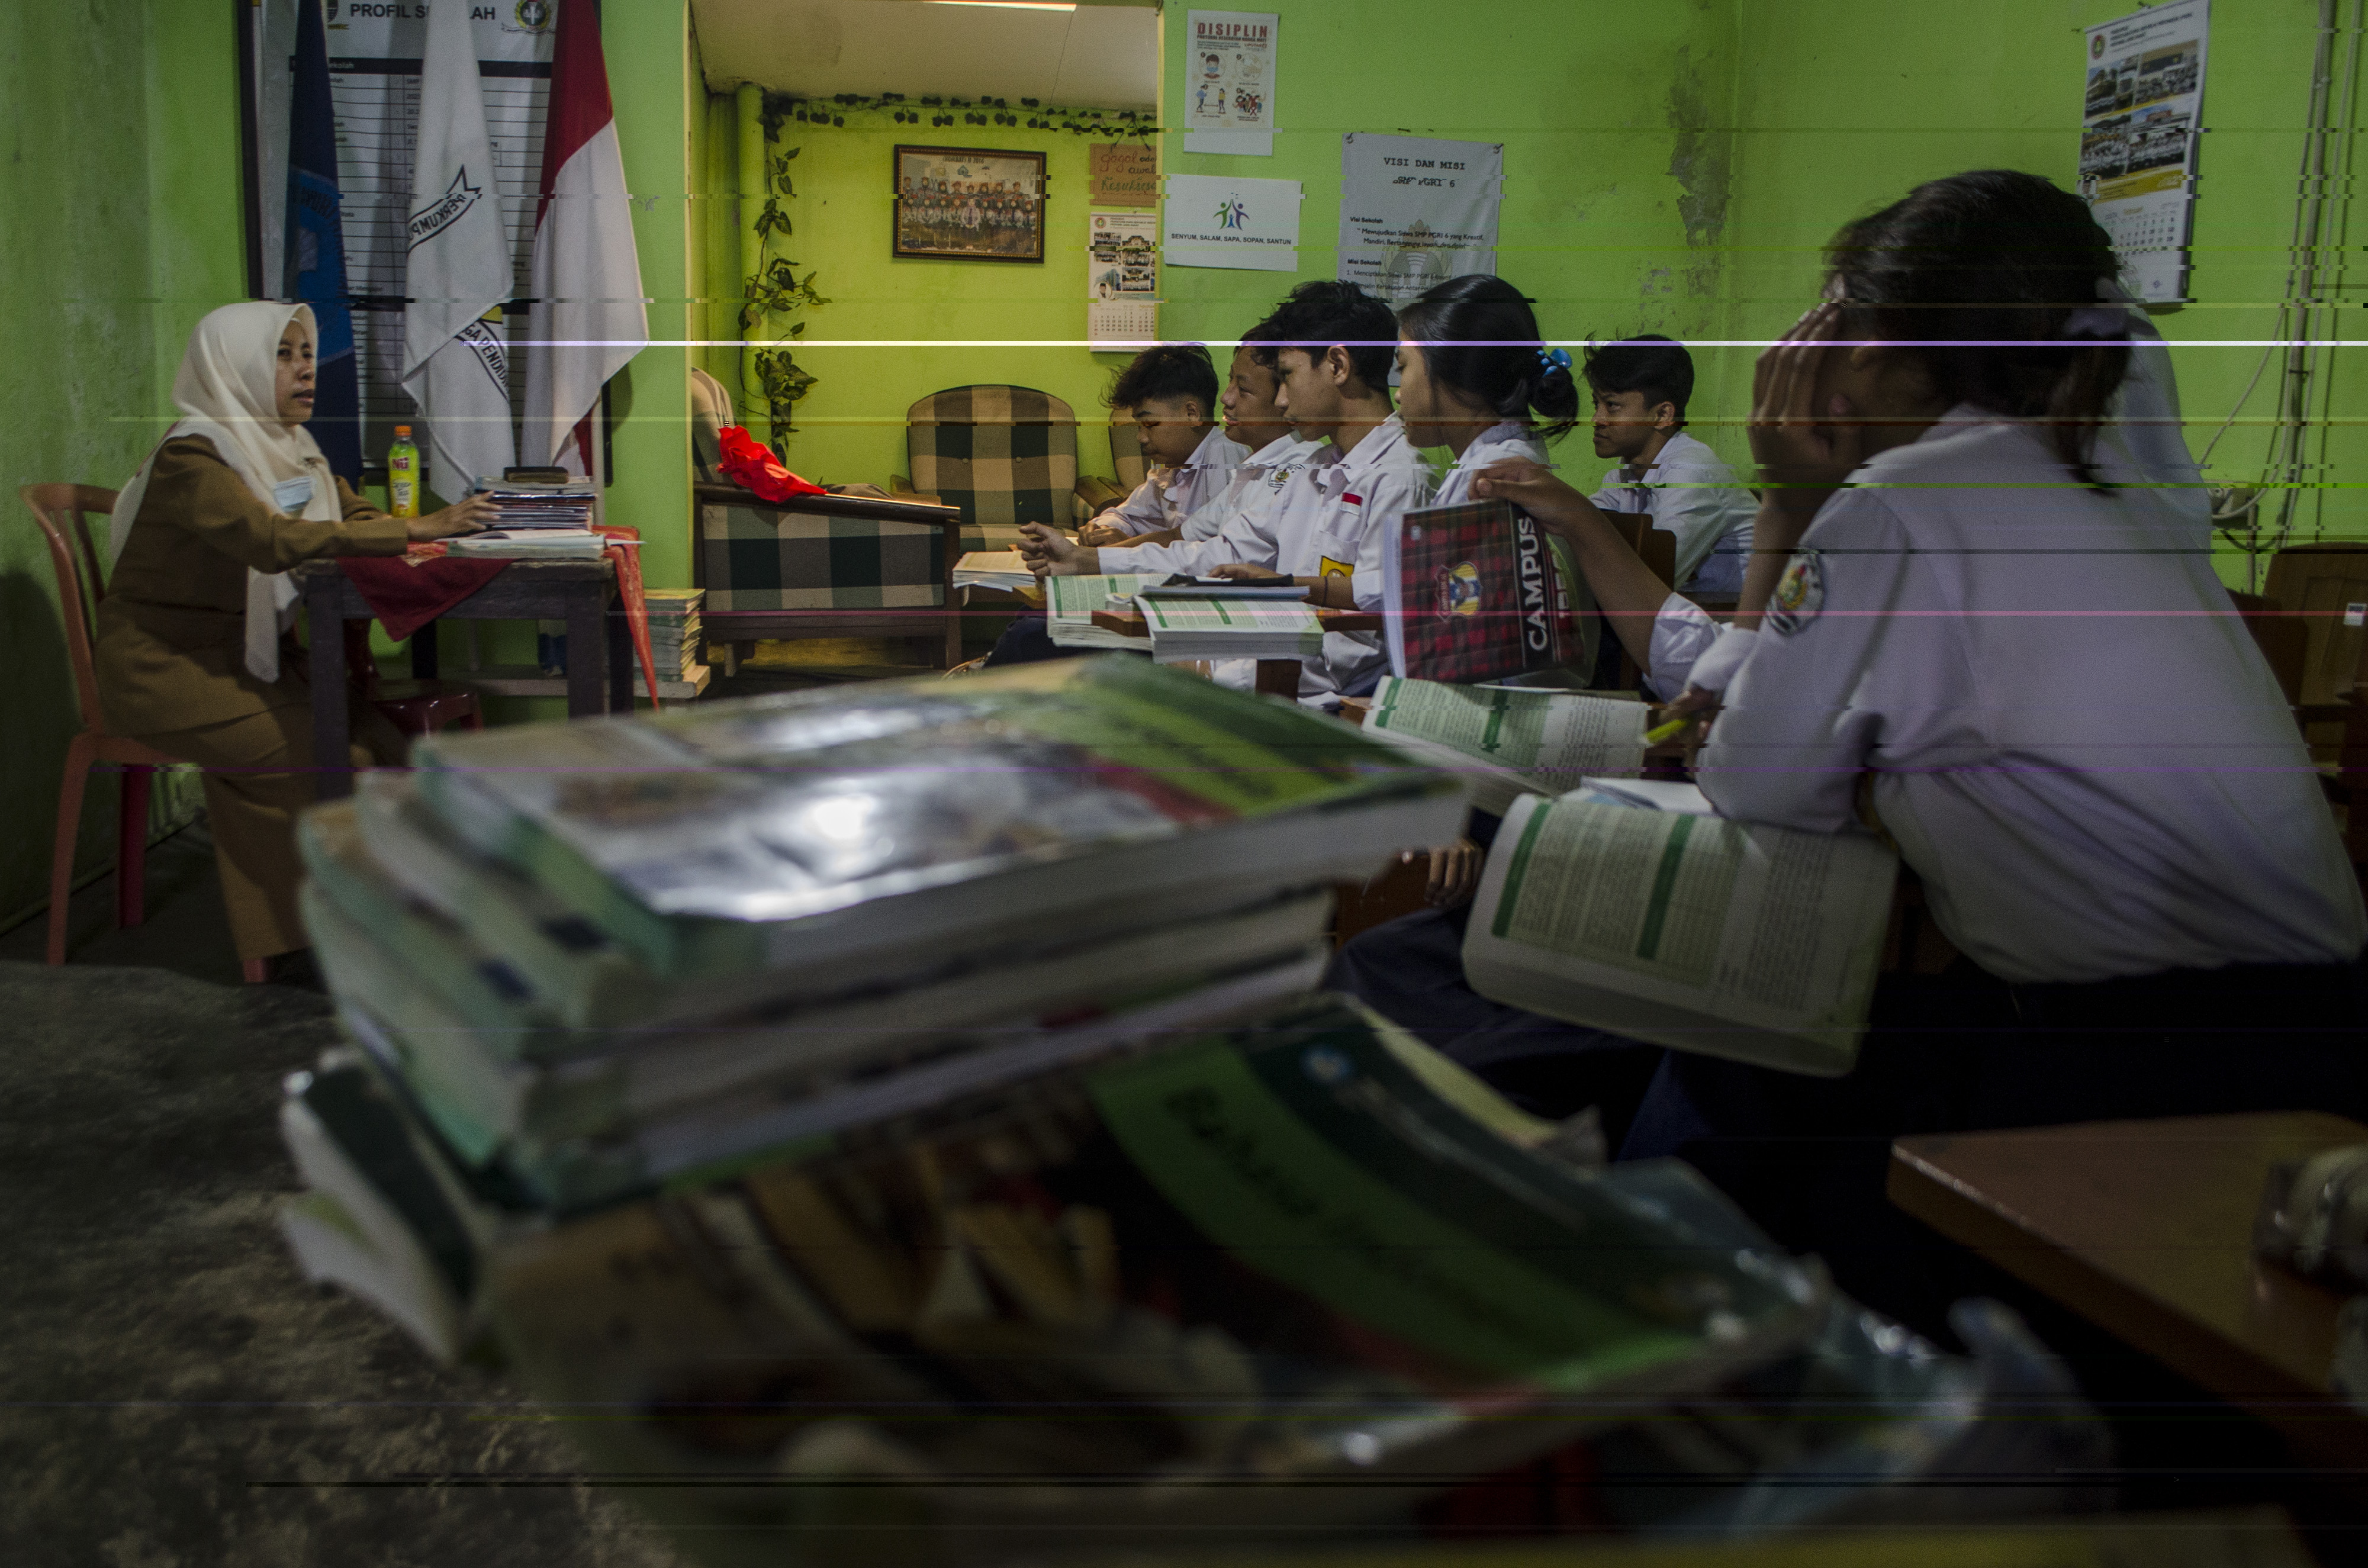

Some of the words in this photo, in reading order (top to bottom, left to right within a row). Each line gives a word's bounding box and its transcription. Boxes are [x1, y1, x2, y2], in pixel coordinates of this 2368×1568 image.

[350, 4, 411, 18] PROFIL
[1197, 22, 1267, 37] DISIPLIN
[1384, 157, 1409, 166] VISI
[1415, 159, 1435, 168] DAN
[1440, 161, 1466, 170] MISI
[1449, 179, 1456, 188] 6
[1517, 515, 1549, 652] CAMPUS
